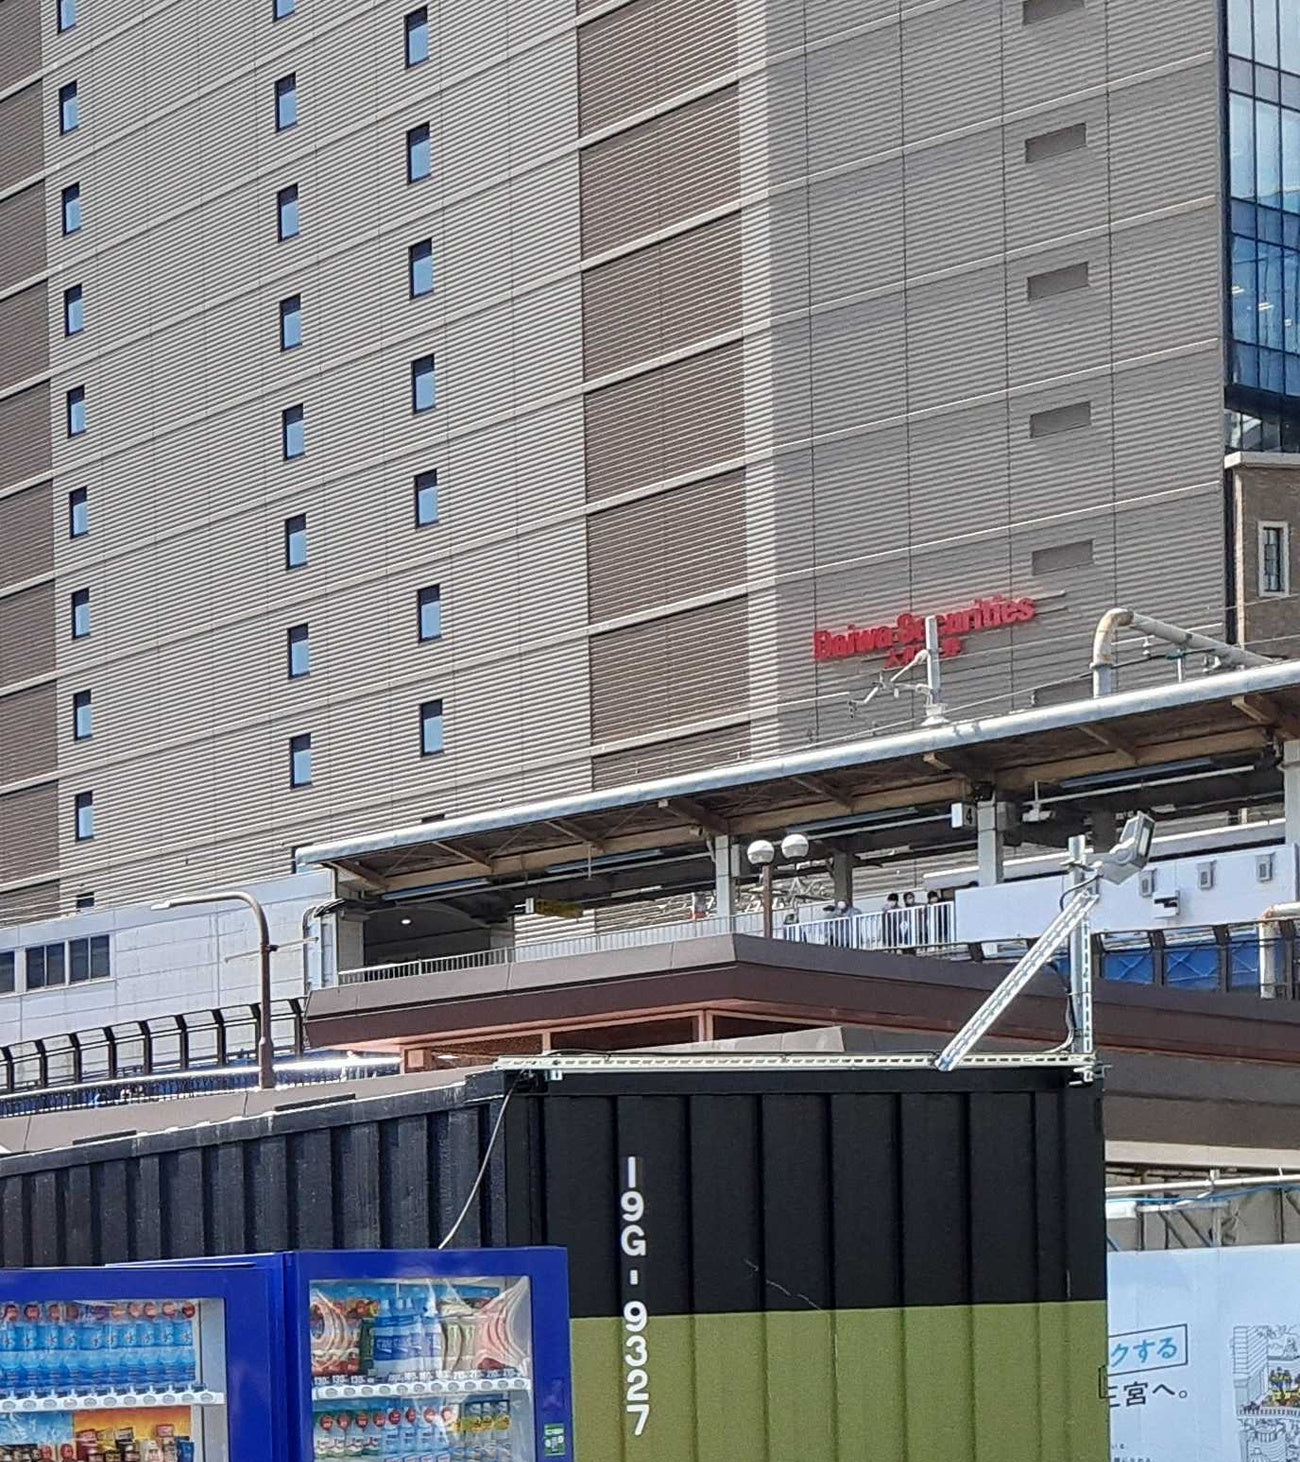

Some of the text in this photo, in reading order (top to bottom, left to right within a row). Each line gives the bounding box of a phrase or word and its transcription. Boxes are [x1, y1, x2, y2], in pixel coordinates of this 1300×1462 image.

[814, 624, 893, 661] Daiwa
[965, 807, 974, 825] 4
[1111, 1337, 1178, 1368] クする
